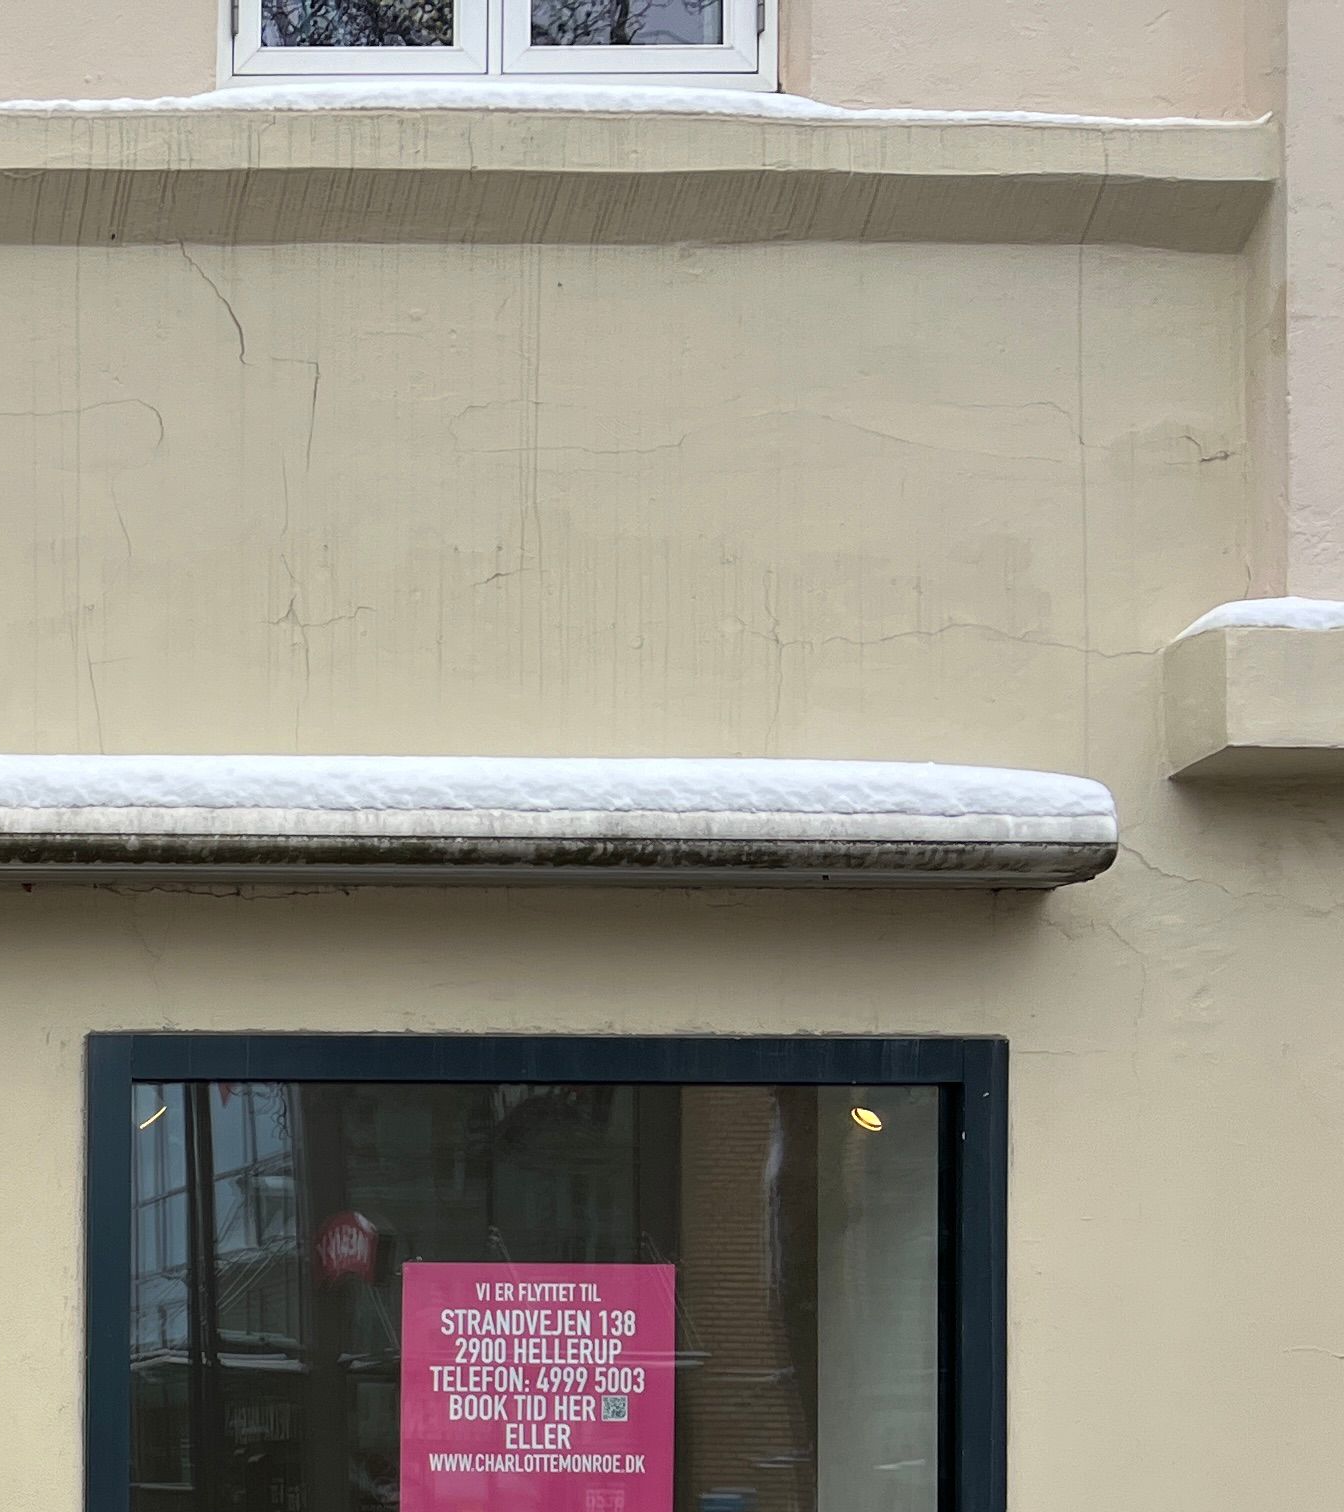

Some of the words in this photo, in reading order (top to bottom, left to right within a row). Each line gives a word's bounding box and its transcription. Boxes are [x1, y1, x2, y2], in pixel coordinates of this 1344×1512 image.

[475, 1282, 490, 1301] VI
[495, 1282, 514, 1302] ER
[518, 1282, 576, 1302] FLYTTET
[579, 1283, 602, 1302] TIL
[441, 1308, 591, 1336] STRANDVEJEN
[598, 1310, 636, 1337] 138
[455, 1337, 507, 1364] 2900
[513, 1337, 622, 1365] HELLERUP
[429, 1365, 530, 1393] TELEFON:
[536, 1366, 588, 1393] 4999
[594, 1366, 645, 1394] 5003
[449, 1394, 508, 1421] BOOK
[513, 1394, 547, 1421] TID
[554, 1395, 596, 1422] HER
[505, 1423, 571, 1450] ELLER
[428, 1453, 646, 1473] WWW.CHARLOTTEMONROE.DK
